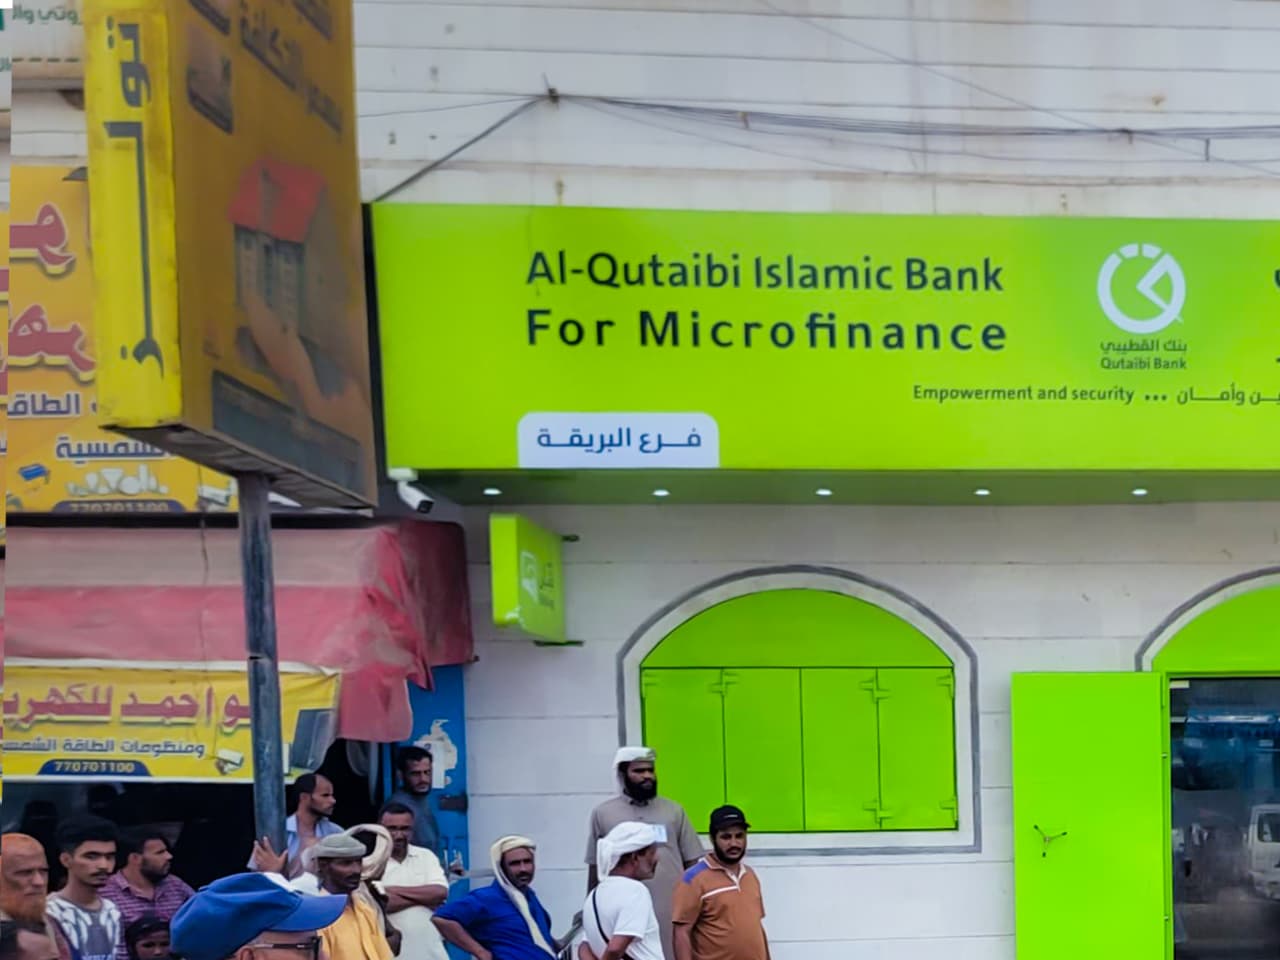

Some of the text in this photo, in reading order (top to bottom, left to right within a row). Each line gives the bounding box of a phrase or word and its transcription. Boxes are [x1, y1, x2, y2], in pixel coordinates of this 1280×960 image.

[527, 250, 1003, 292] Al-Qutaibi Islamic Bank
[527, 308, 1008, 351] For Microfinance
[1100, 340, 1187, 355] بنك القطيبي
[1101, 357, 1187, 370] Qutaibi Bank
[913, 385, 1033, 404] Empowerment
[1038, 386, 1068, 400] and
[1072, 385, 1135, 405] security
[1177, 382, 1246, 405] وأمان
[536, 426, 702, 454] فرع البريقة
[121, 685, 214, 725] احمد
[63, 739, 115, 752] الطاقة
